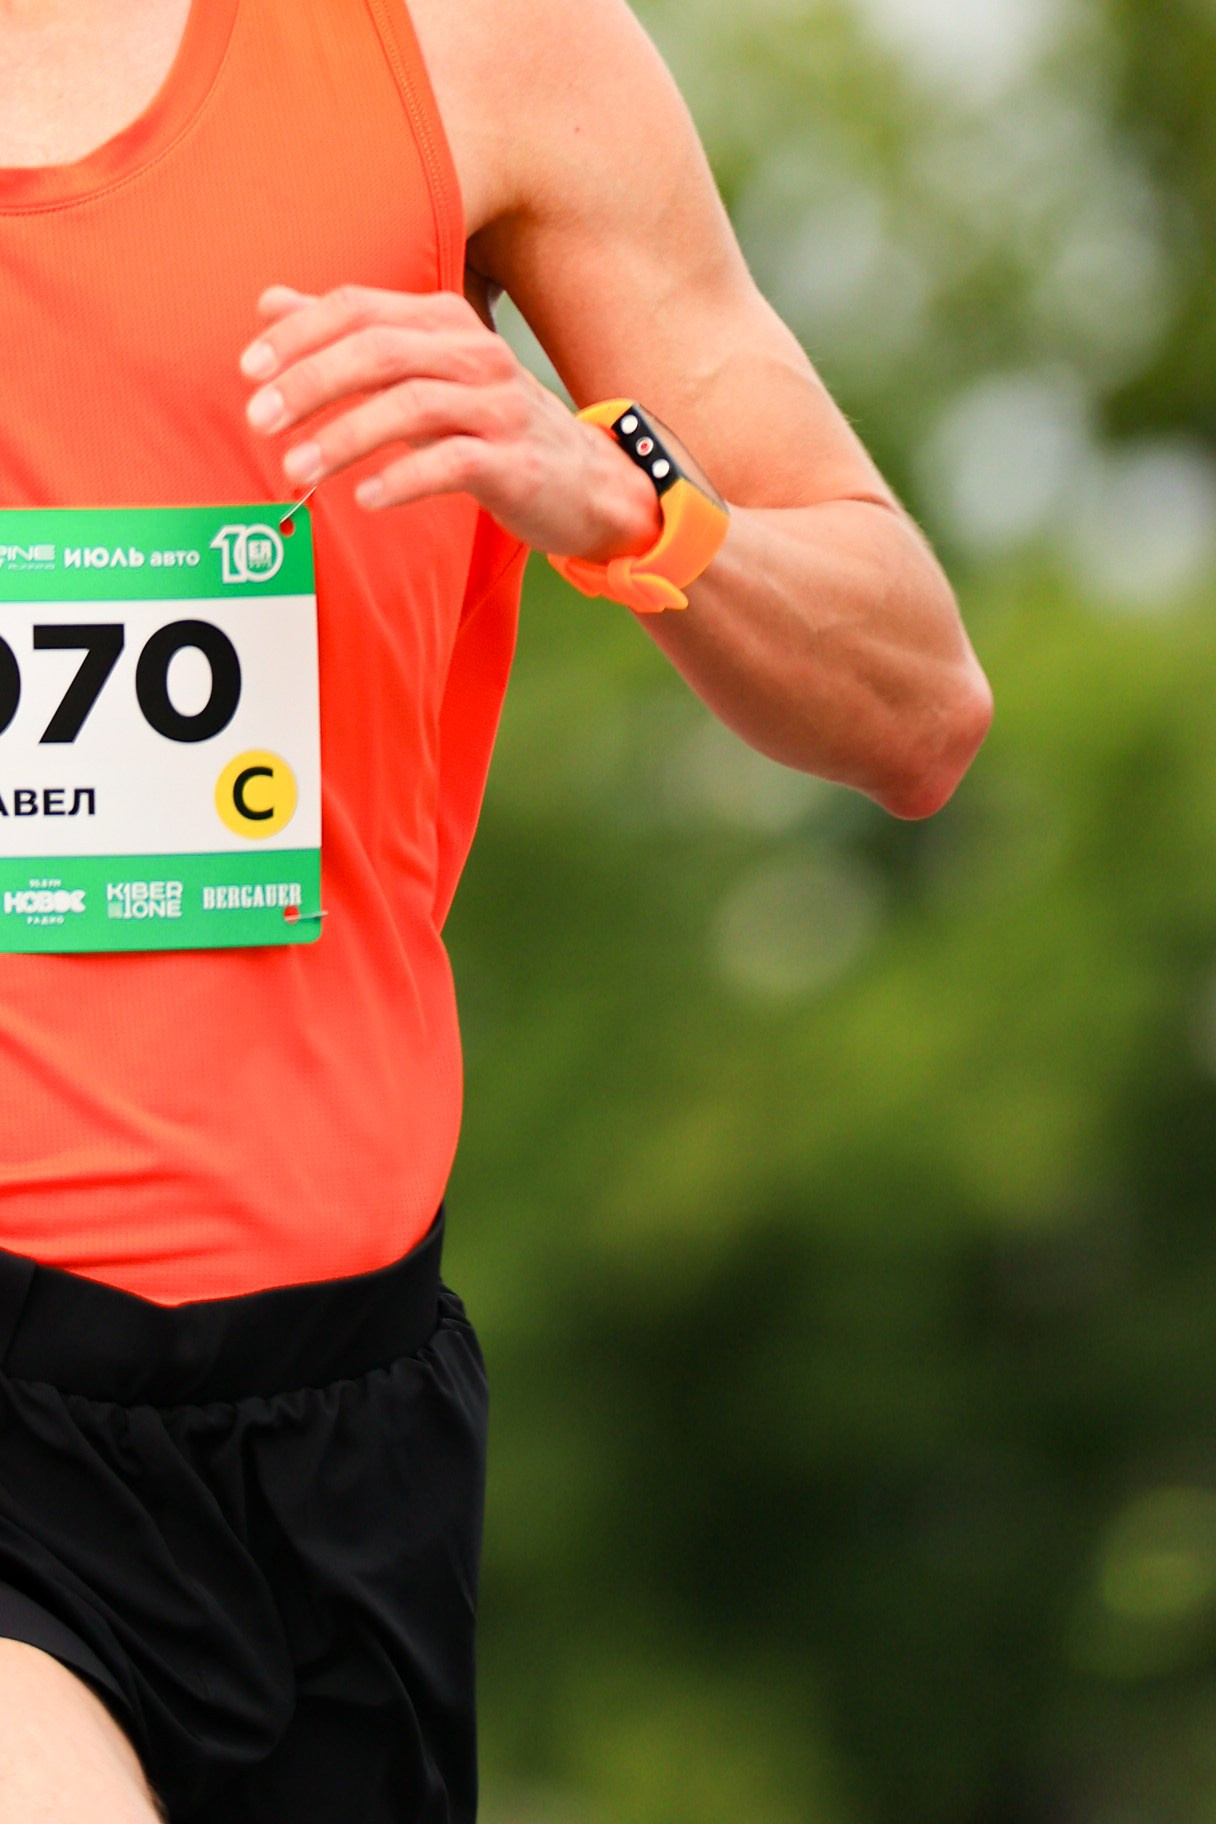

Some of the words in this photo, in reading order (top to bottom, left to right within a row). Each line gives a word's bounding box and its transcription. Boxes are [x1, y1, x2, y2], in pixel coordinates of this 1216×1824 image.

[63, 547, 145, 569] ИЮЛЬ
[149, 549, 201, 567] авто
[26, 916, 65, 926] РАДИО
